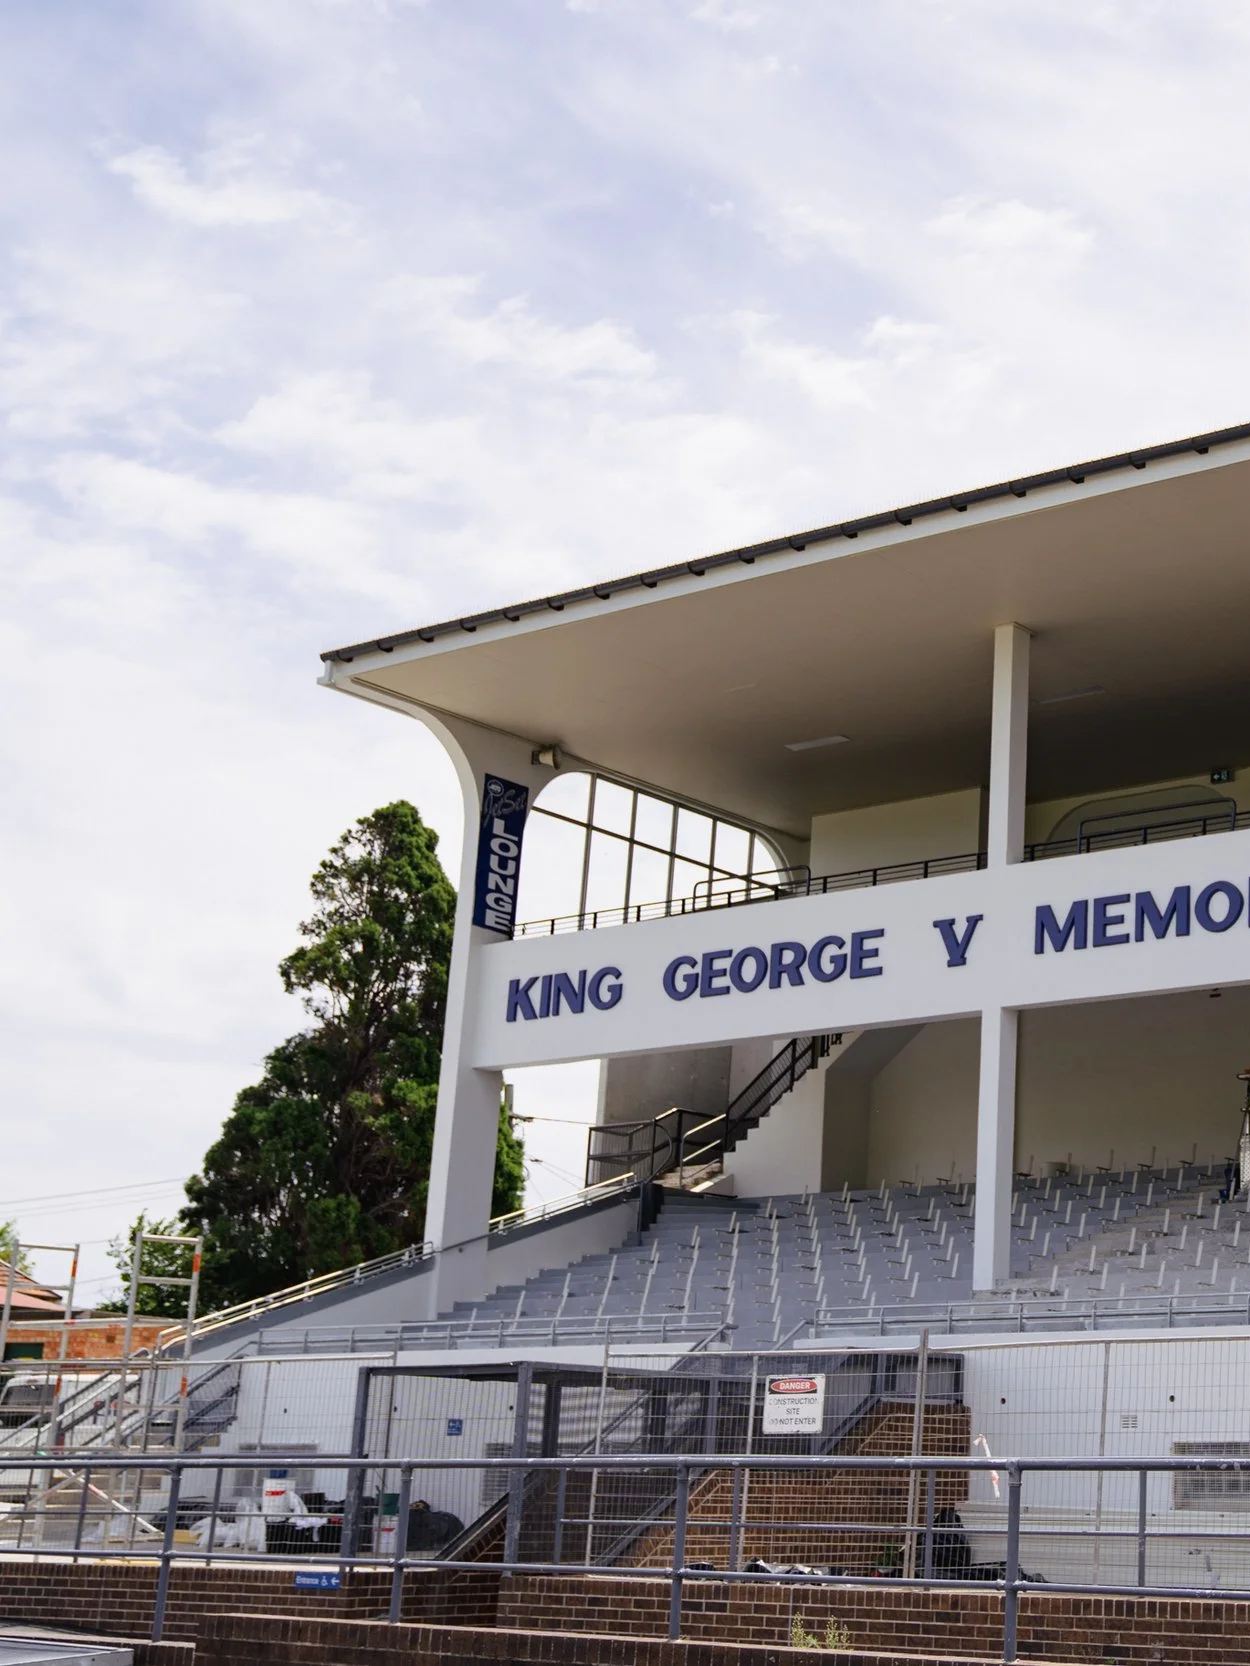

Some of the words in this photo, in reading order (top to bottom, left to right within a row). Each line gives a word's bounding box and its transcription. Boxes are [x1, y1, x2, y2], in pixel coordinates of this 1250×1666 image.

[484, 818, 519, 933] LOUNGE
[506, 966, 623, 1022] KING
[663, 928, 884, 1002] GEORGE
[932, 914, 983, 967] V
[779, 1382, 810, 1390] DANGER
[794, 1417, 816, 1425] ENTER
